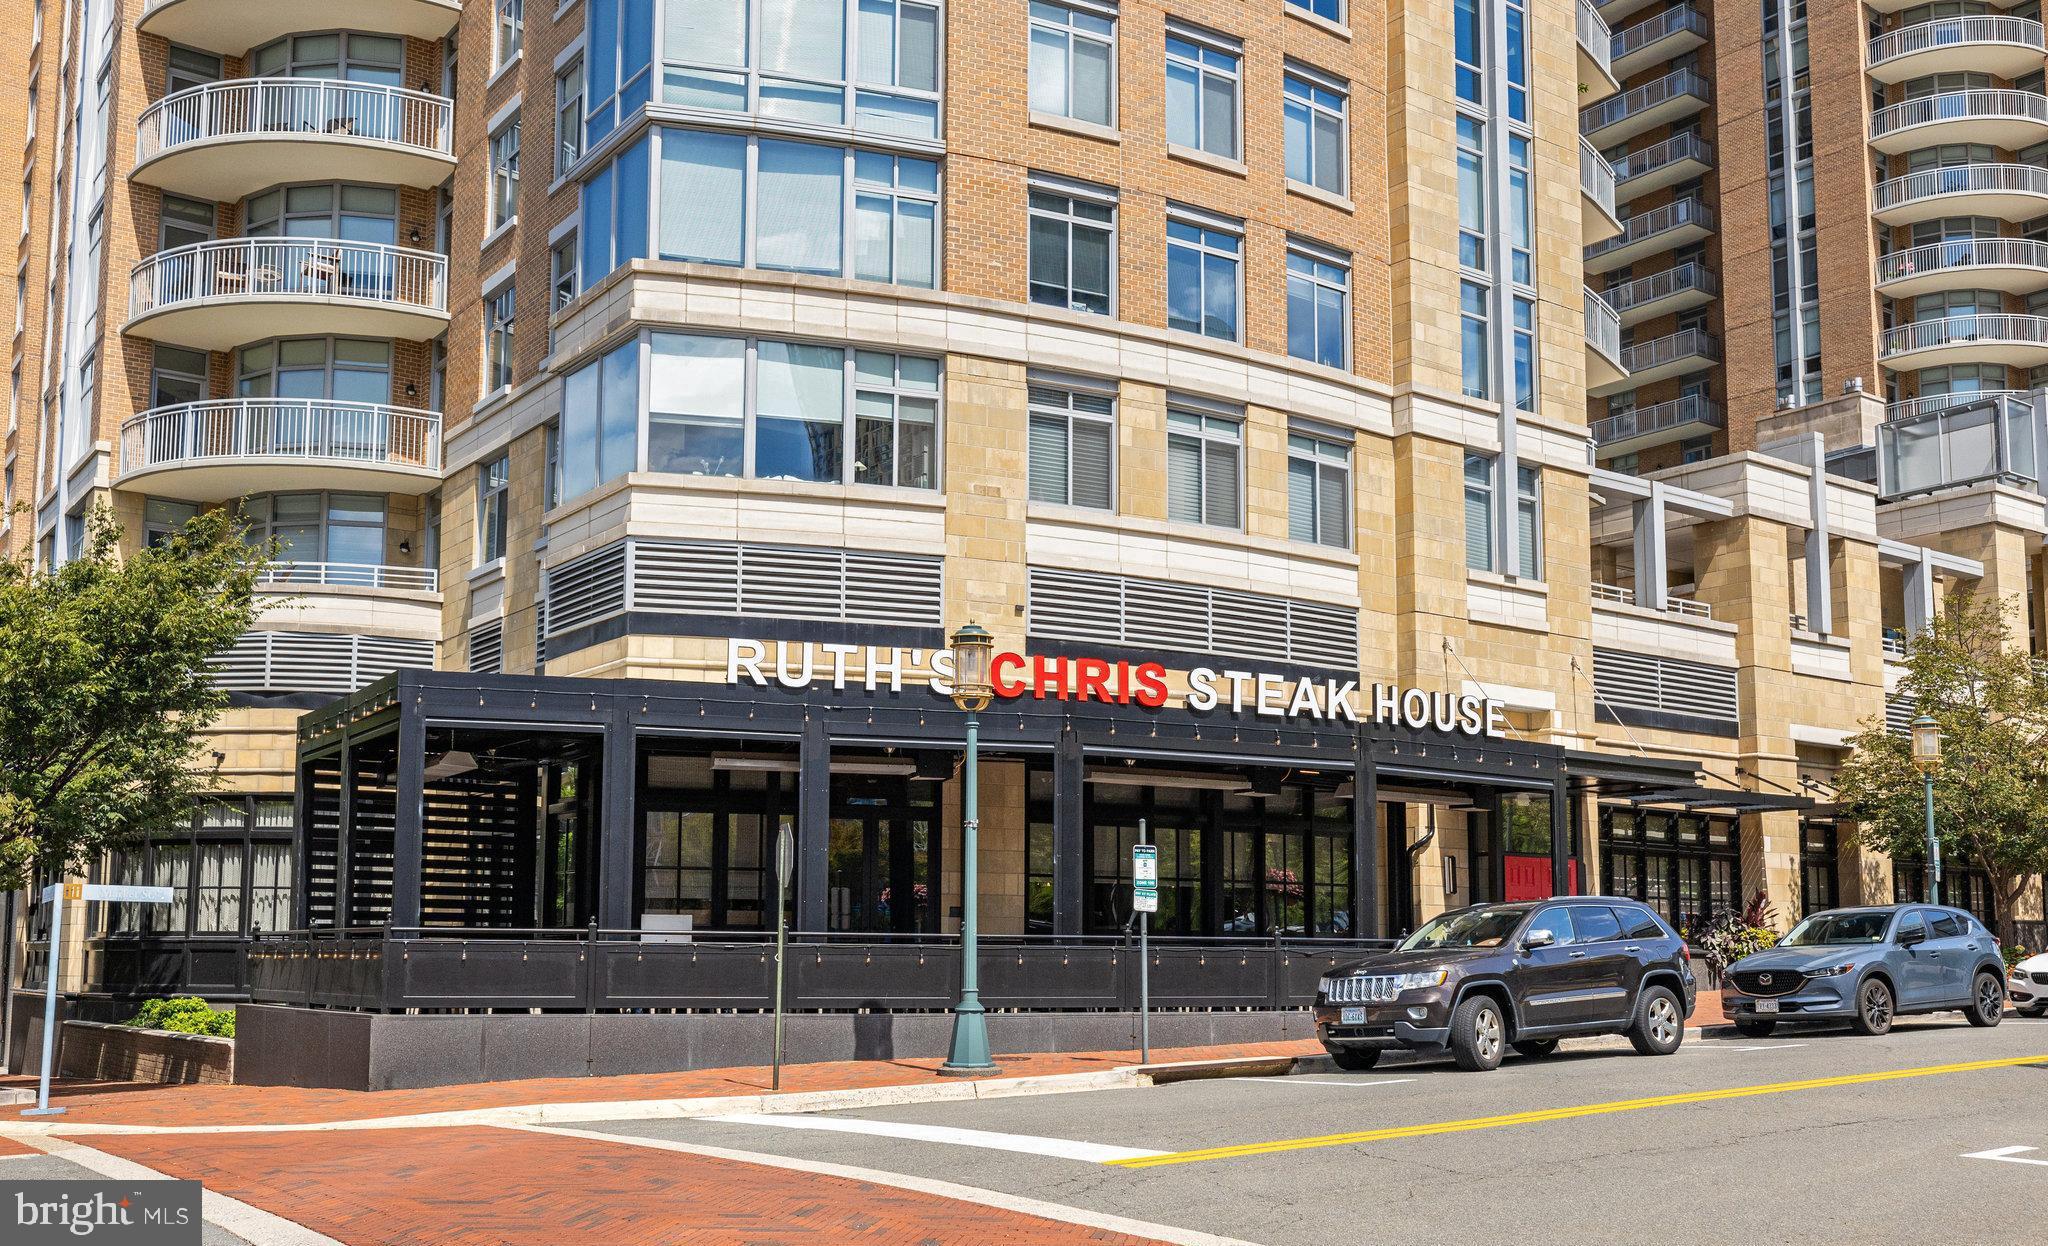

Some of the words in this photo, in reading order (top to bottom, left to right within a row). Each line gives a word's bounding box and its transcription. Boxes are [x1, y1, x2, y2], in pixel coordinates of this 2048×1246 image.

[726, 638, 954, 695] RUTH'S
[990, 652, 1168, 707] CHRIS
[1187, 667, 1358, 721] STEAK
[1371, 683, 1506, 738] HOUSE
